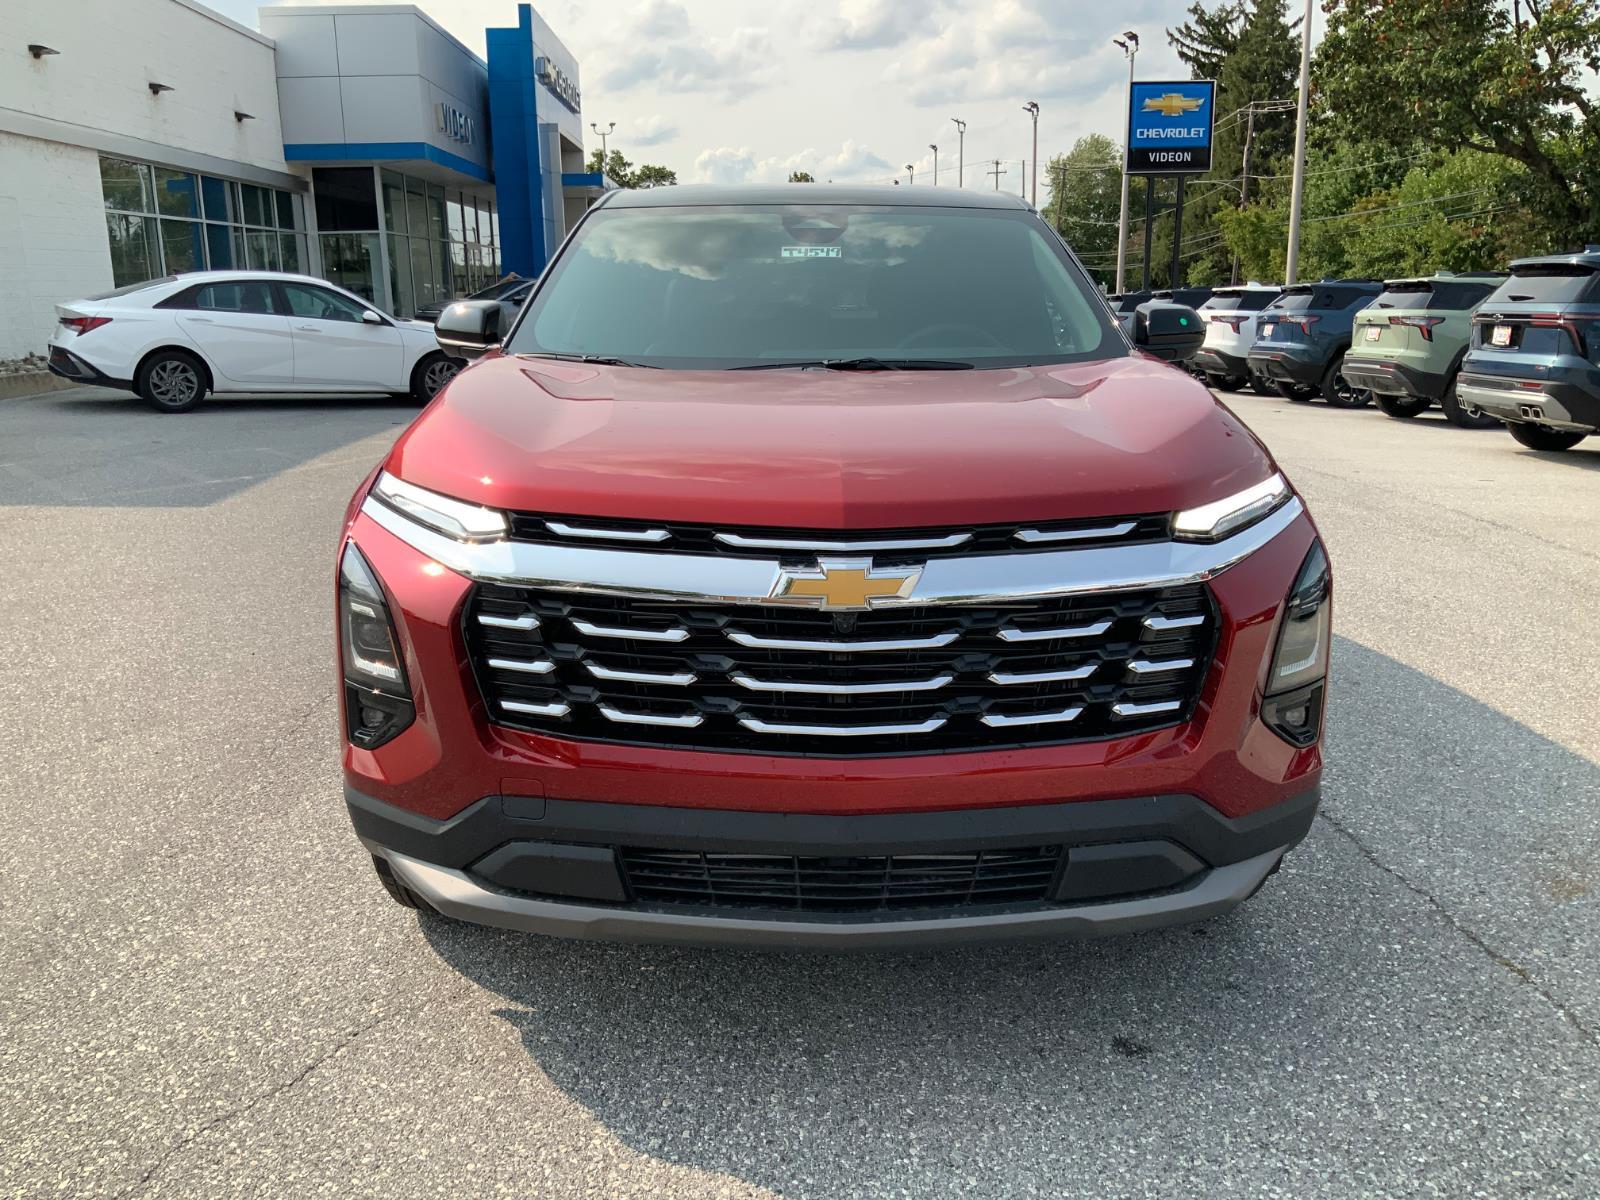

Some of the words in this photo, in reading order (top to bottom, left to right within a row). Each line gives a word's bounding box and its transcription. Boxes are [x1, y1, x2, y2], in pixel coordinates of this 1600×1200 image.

[435, 102, 474, 144] VIDEON
[1136, 127, 1206, 139] CHEVROLET
[1148, 151, 1192, 162] VIDEON
